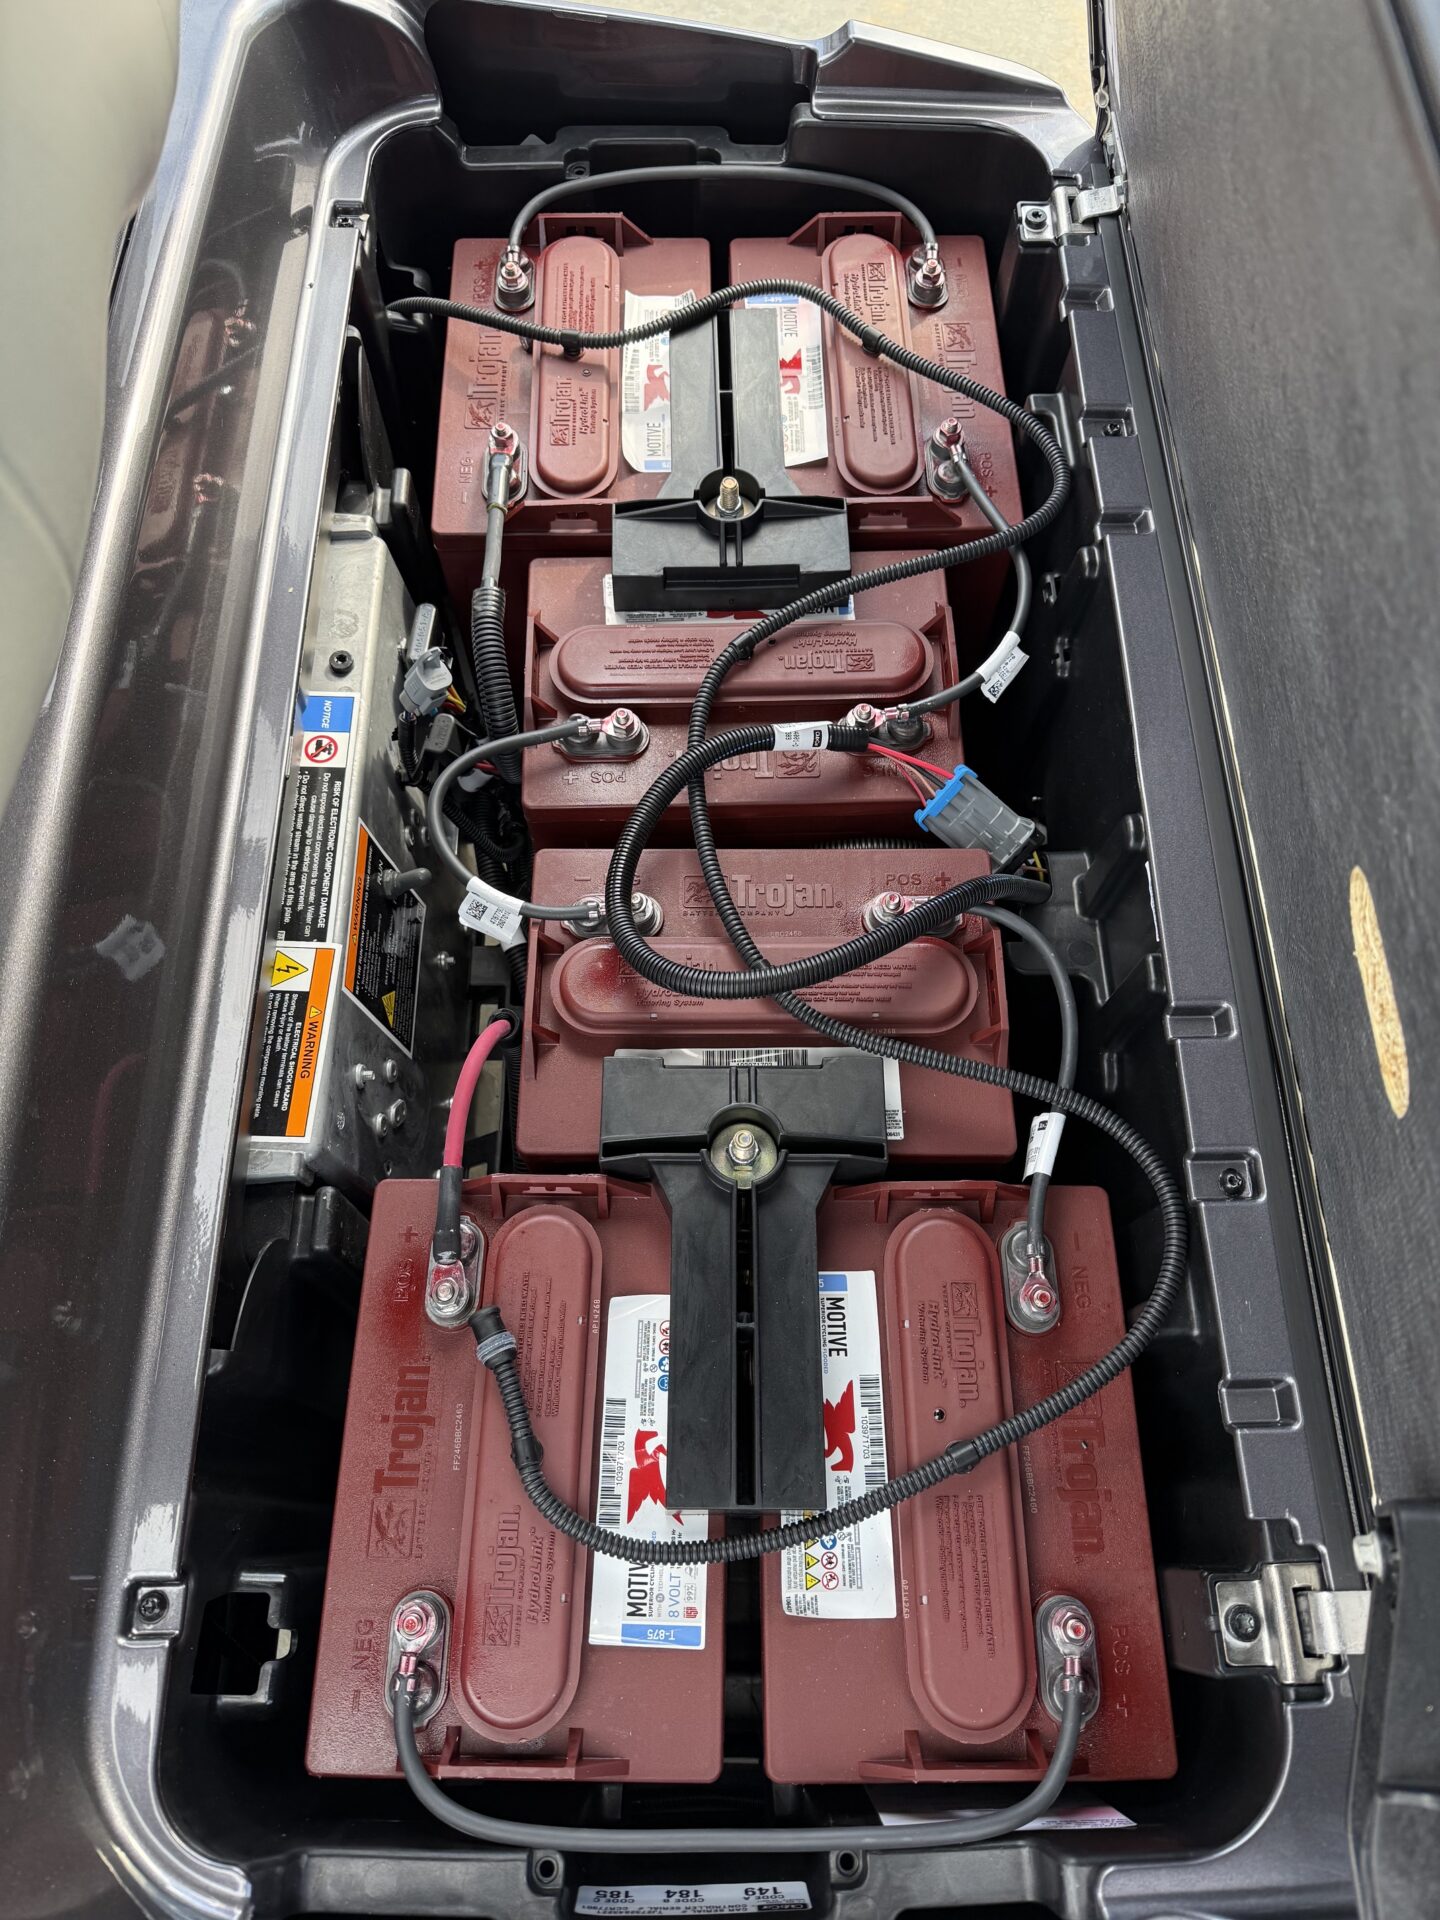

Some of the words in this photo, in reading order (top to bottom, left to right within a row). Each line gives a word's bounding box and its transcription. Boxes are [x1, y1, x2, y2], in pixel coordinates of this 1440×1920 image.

[867, 281, 890, 322] Trojan
[783, 306, 798, 337] MOTIVE
[466, 334, 502, 400] Trojan
[550, 382, 572, 425] Trojan
[646, 422, 661, 457] MOTIVE
[782, 649, 846, 674] Trojan
[321, 700, 334, 729] NOTICE
[301, 785, 309, 794] not
[302, 775, 310, 784] Do
[321, 782, 329, 792] not
[323, 773, 331, 781] Do
[333, 781, 343, 796] RISK
[591, 771, 626, 784] POS
[319, 793, 327, 813] expose
[332, 797, 341, 807] OF
[306, 814, 317, 838] damage
[316, 814, 326, 841] electrical
[327, 808, 339, 850] ELECTRONIC
[293, 831, 303, 851] stream
[291, 860, 300, 870] the
[303, 846, 312, 872] electrical
[312, 841, 322, 879] components
[289, 871, 297, 885] area
[321, 852, 334, 896] COMPONENT
[885, 872, 921, 887] POS
[288, 886, 296, 894] of
[353, 876, 362, 930] WARNING
[731, 874, 837, 916] Trojan
[306, 905, 315, 924] Water
[317, 897, 327, 929] DAMAGE
[304, 925, 312, 937] can
[274, 992, 282, 1009] When
[282, 993, 290, 1013] serious
[288, 993, 299, 1016] Shorting
[268, 1010, 278, 1035] removing
[279, 1013, 287, 1028] injury
[286, 1023, 294, 1032] the
[281, 1032, 292, 1051] battery
[290, 1022, 302, 1060] ELECTRICAL
[300, 1021, 319, 1079] WARNING
[261, 1045, 272, 1076] component
[278, 1052, 289, 1078] terminals
[286, 1061, 296, 1084] SHOCK
[256, 1077, 267, 1103] mounting
[273, 1090, 281, 1108] cause
[281, 1085, 291, 1112] HAZARD
[1072, 1266, 1091, 1308] NEG
[592, 1299, 600, 1334] AP14268
[826, 1297, 848, 1357] MOTIVE
[952, 1319, 985, 1401] Trojan
[372, 1364, 436, 1495] Trojan
[860, 1414, 871, 1460] 103971703
[615, 1441, 625, 1486] 103971703
[1056, 1421, 1112, 1554] Trojan
[484, 1512, 524, 1603] Trojan
[544, 1531, 556, 1573] System
[980, 1550, 990, 1597] BATTERIES
[541, 1575, 554, 1624] Watering
[626, 1560, 649, 1617] MOTIV
[668, 1572, 681, 1607] VOLT
[686, 1584, 694, 1601] 99%
[668, 1610, 680, 1618] 8
[685, 1606, 698, 1618] USA
[984, 1599, 992, 1622] NEED
[351, 1619, 373, 1671] NEG
[647, 1629, 676, 1640] T-875
[987, 1625, 996, 1657] WATER
[1111, 1624, 1131, 1675] POS
[595, 1890, 634, 1899] 185
[664, 1889, 704, 1899] 184
[744, 1887, 782, 1896] 149
